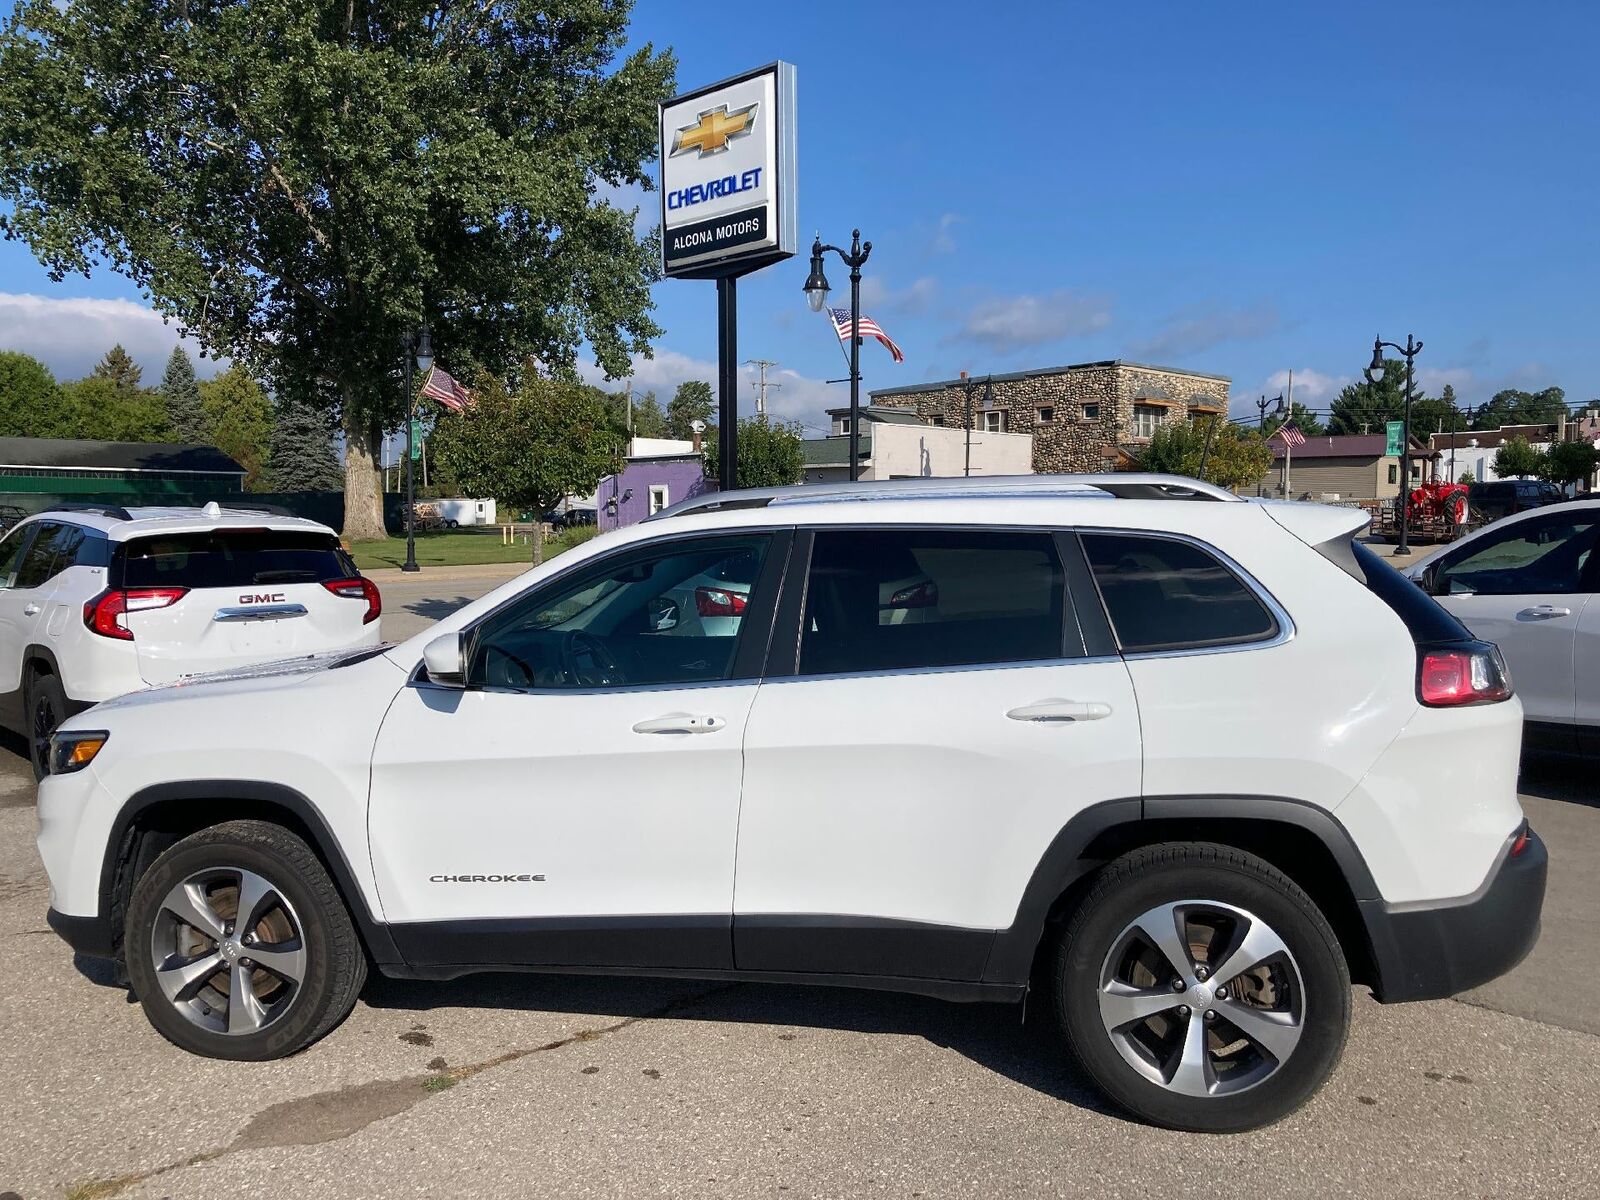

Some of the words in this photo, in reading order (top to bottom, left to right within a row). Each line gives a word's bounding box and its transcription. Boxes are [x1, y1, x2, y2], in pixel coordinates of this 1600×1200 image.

[667, 167, 762, 210] CHEVROLET
[673, 229, 713, 250] ALCONA
[716, 217, 759, 240] MOTORS
[239, 593, 286, 604] GMC
[429, 874, 546, 883] CHEROKEE
